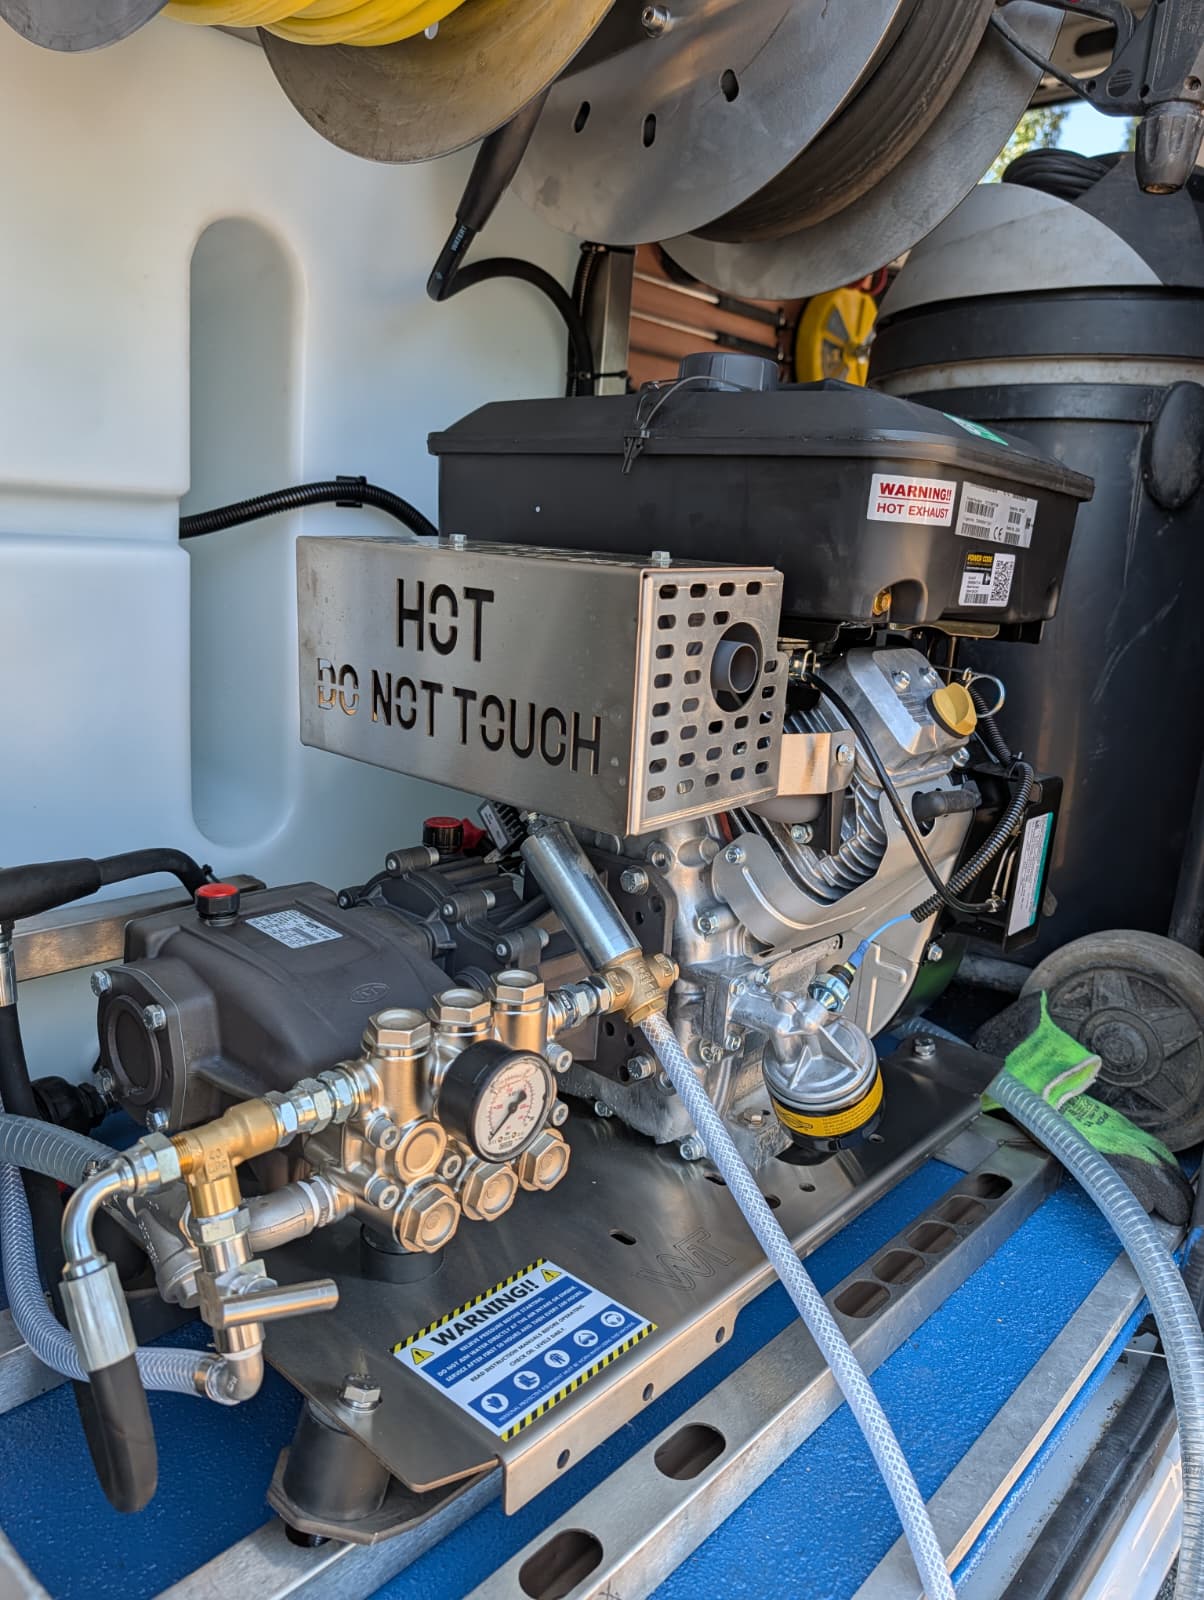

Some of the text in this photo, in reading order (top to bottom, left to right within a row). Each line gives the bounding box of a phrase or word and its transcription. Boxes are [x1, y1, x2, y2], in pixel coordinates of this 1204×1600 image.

[880, 482, 952, 501] WARNING!!
[877, 502, 949, 519] HOT EXHAUST
[396, 578, 495, 662] HOT
[317, 658, 602, 777] DO NOT TOUCH
[429, 1278, 540, 1348] WARNING!!
[501, 1310, 521, 1324] BEFORE
[468, 1341, 489, 1355] WATER
[486, 1327, 512, 1344] DIRECTLY
[483, 1348, 519, 1372] INSTRUCTION
[516, 1332, 543, 1350] MANUALS
[540, 1321, 560, 1334] BEFORE
[508, 1353, 527, 1366] CHECK
[533, 1336, 552, 1349] LEVELS
[465, 1355, 484, 1368] AFTER
